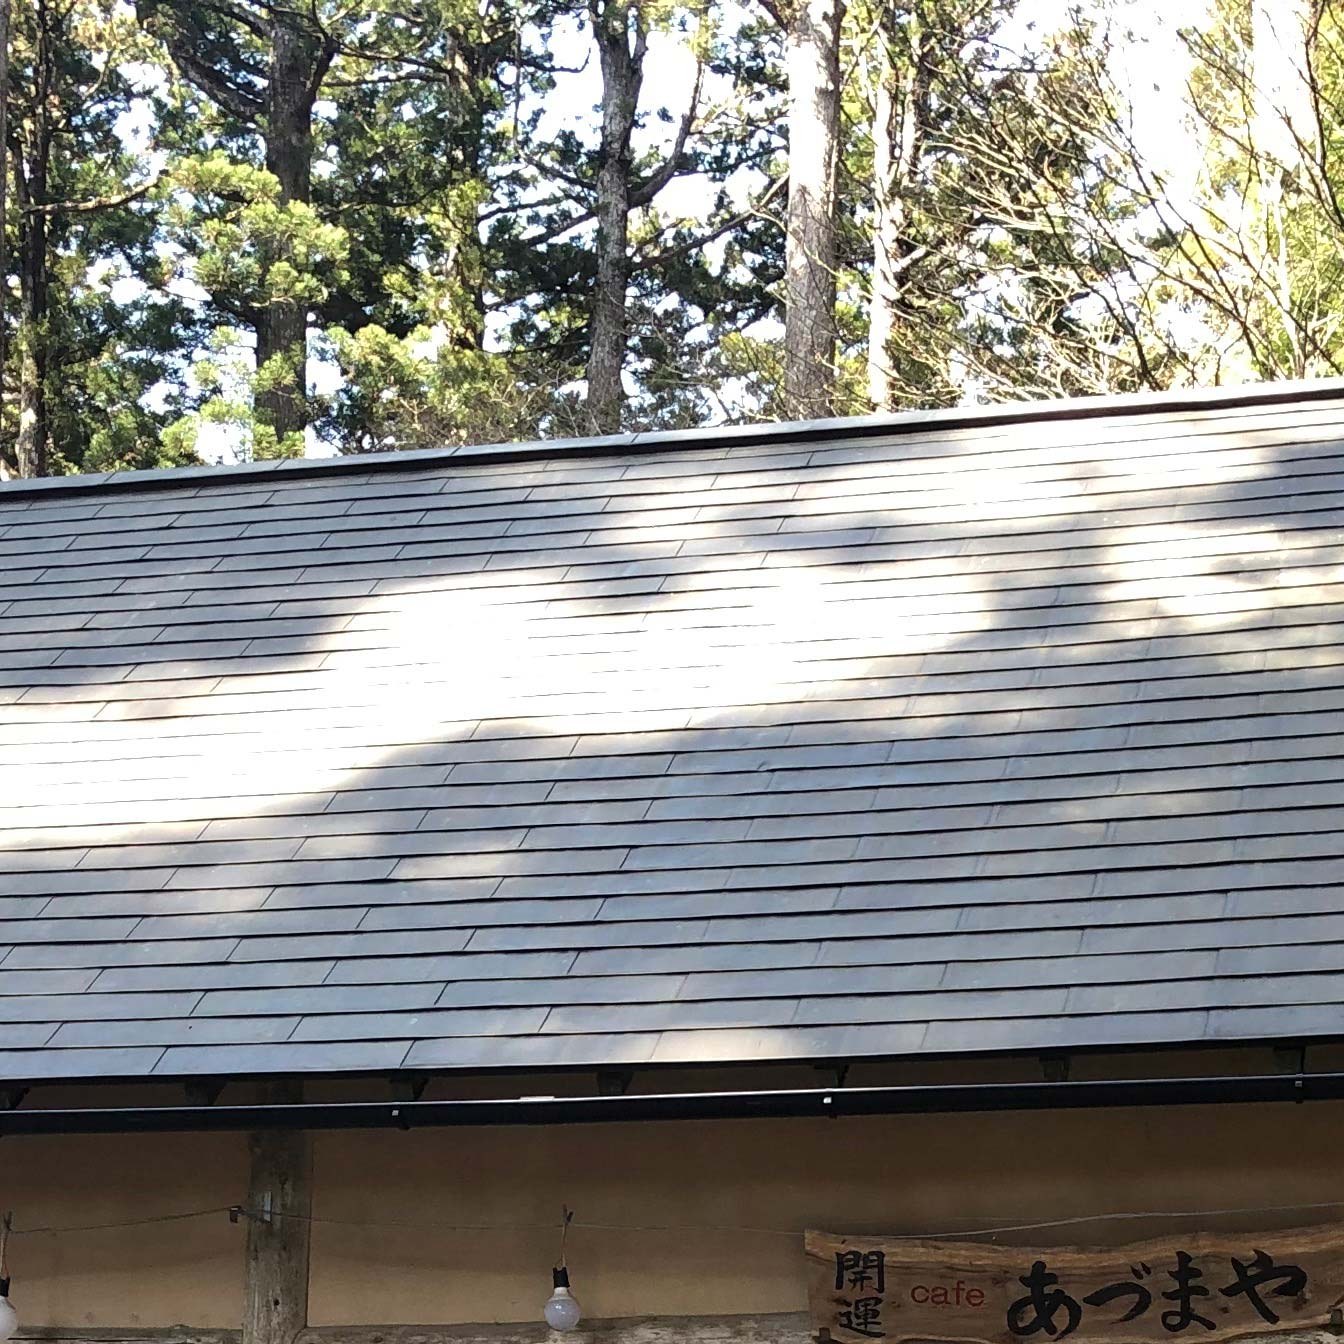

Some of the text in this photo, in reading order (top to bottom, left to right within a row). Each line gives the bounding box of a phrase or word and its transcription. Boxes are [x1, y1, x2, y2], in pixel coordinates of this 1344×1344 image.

[835, 1250, 885, 1338] 開運
[911, 1281, 985, 1308] cafe
[1006, 1250, 1309, 1342] あづまや
